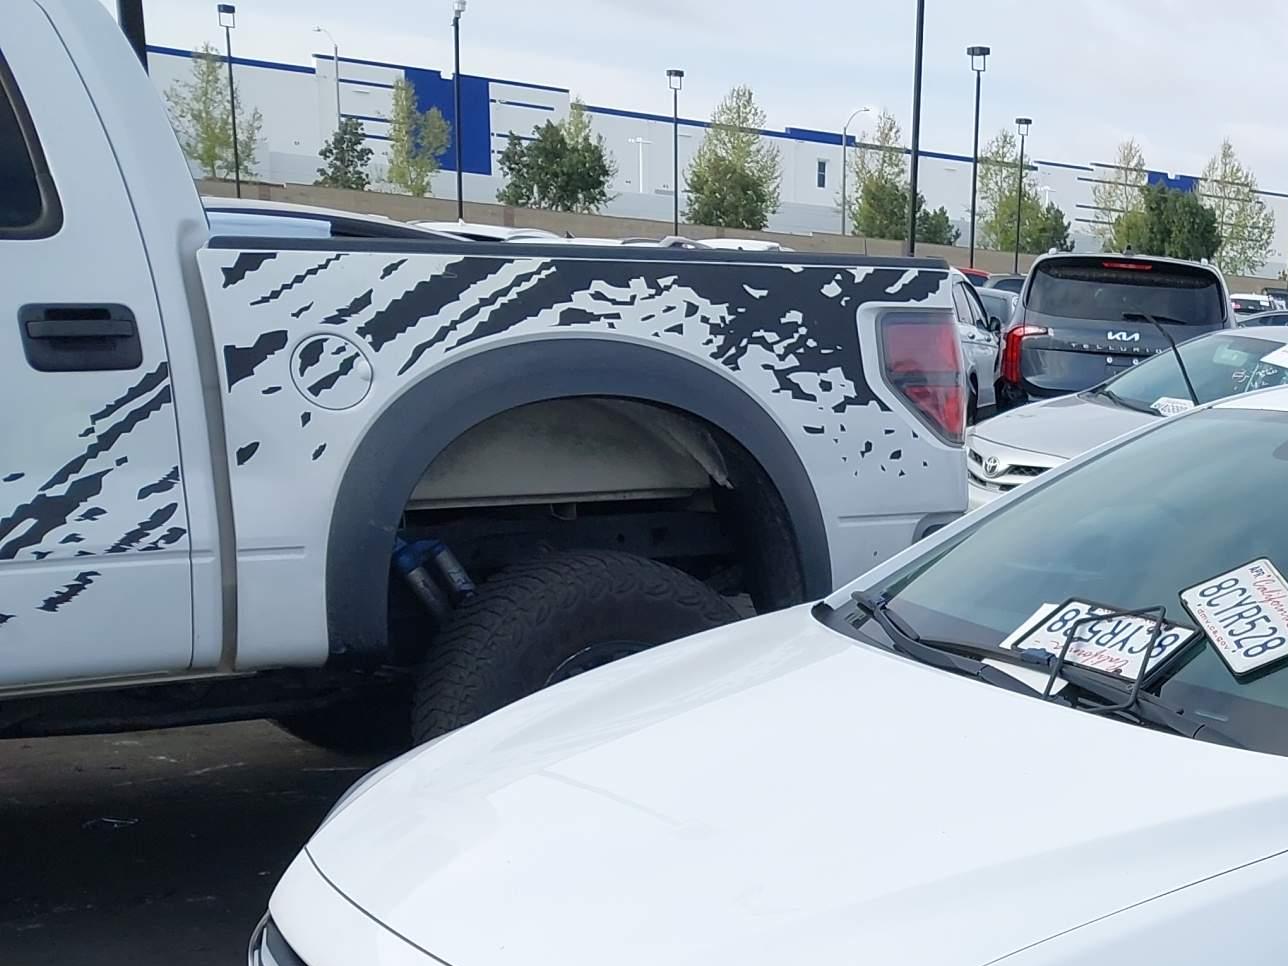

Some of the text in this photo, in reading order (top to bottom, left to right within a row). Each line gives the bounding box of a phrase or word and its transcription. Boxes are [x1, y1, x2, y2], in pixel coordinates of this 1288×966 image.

[1107, 331, 1140, 341] KIA
[1250, 566, 1265, 579] APR
[1197, 608, 1229, 650] dmv.ca.gov
[1199, 578, 1286, 658] 8CYR528
[1051, 640, 1129, 672] Californa
